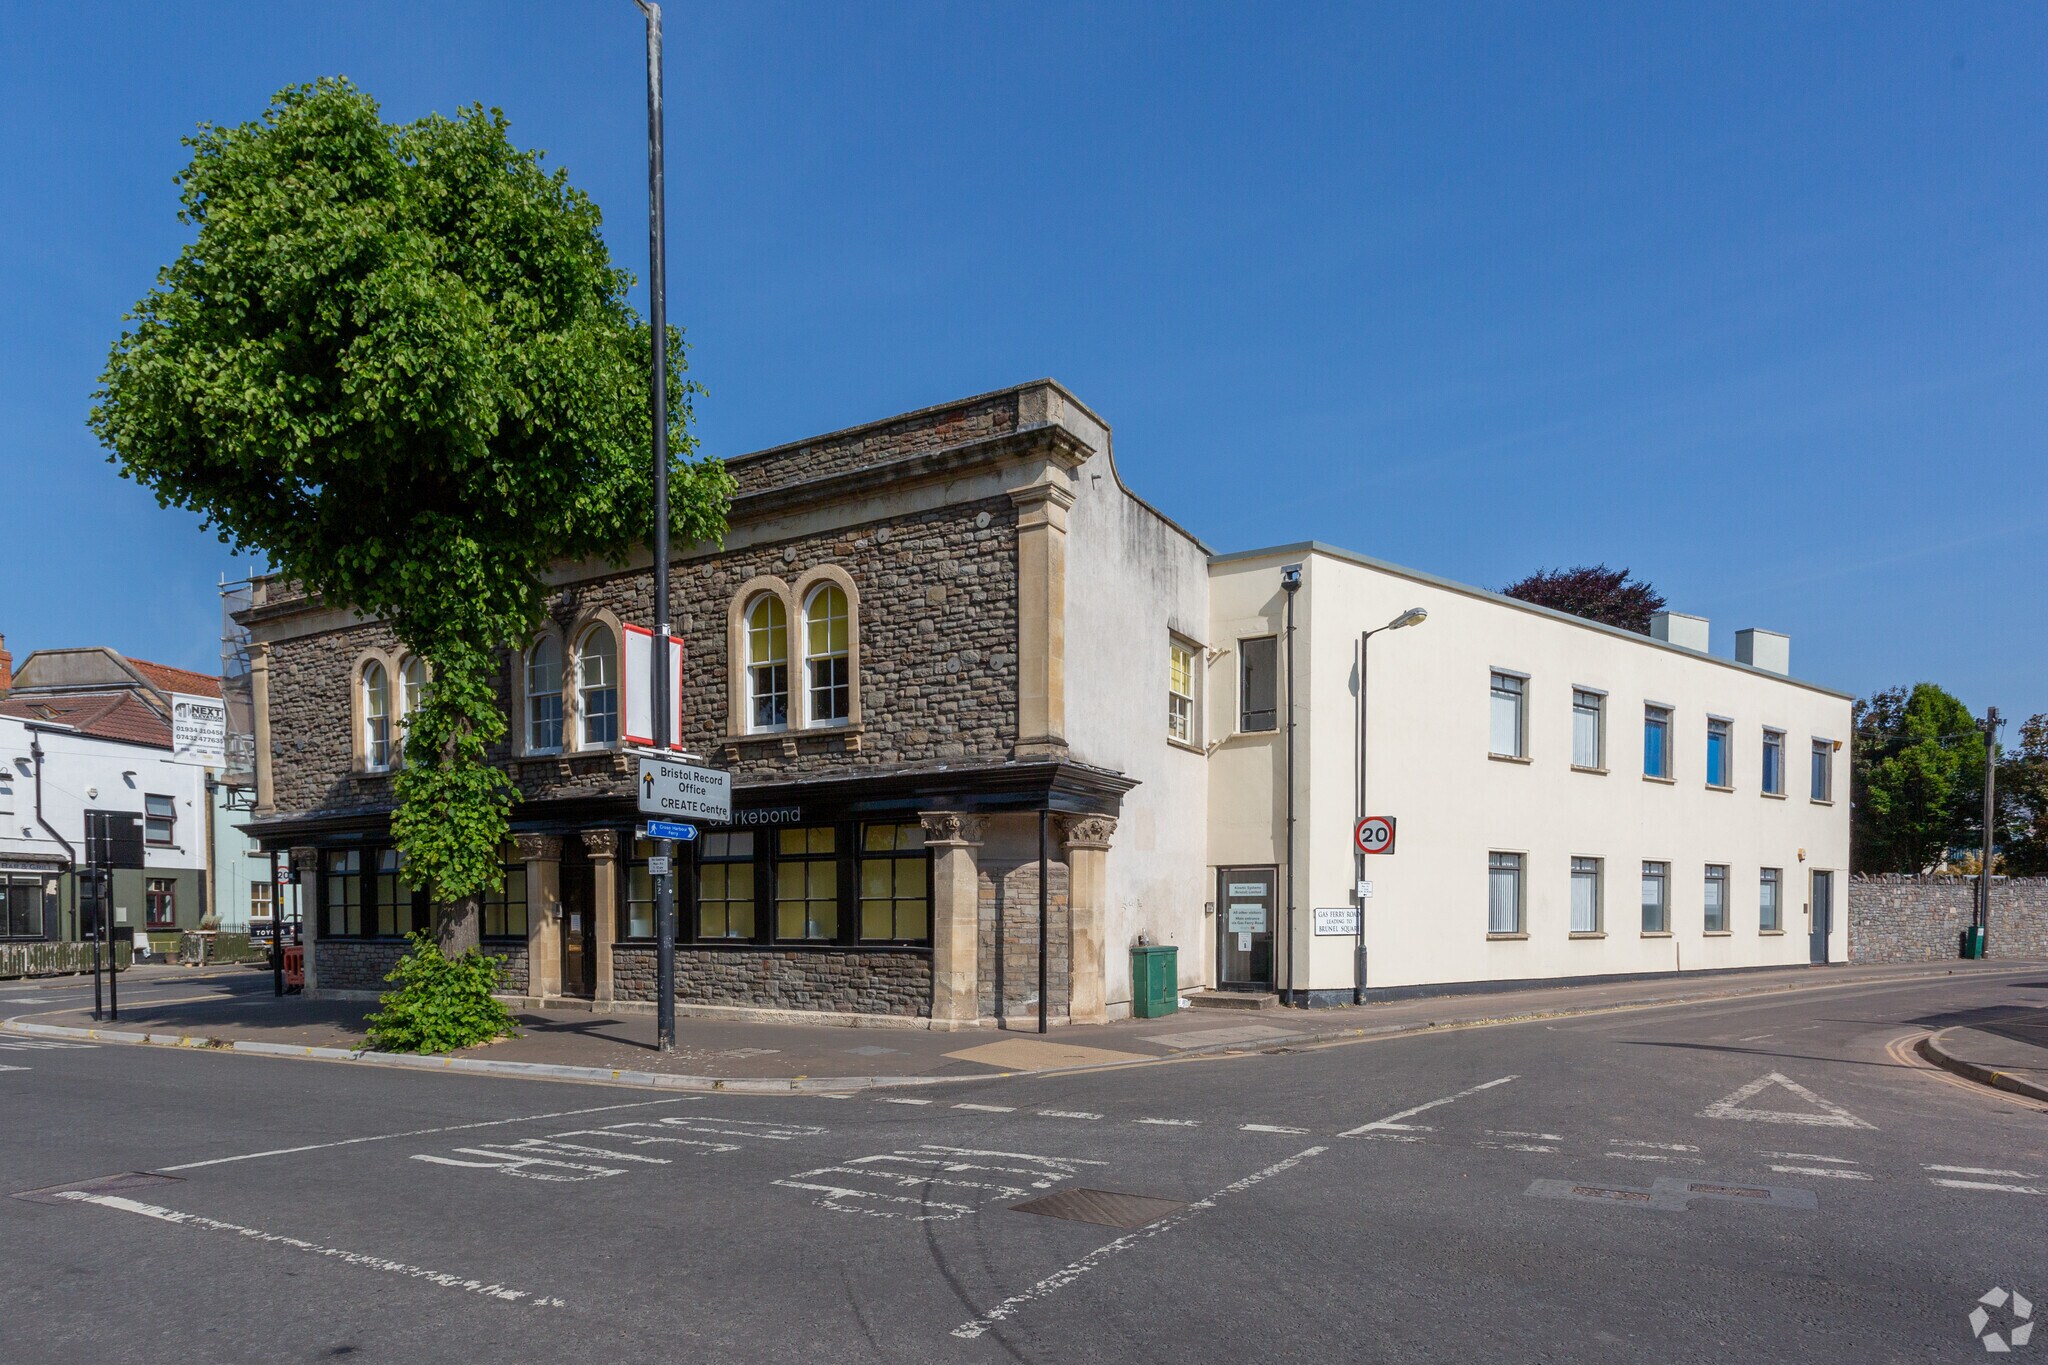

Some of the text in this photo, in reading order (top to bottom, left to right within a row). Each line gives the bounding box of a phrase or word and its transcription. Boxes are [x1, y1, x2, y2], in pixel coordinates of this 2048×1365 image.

[192, 706, 221, 716] NEXT
[661, 767, 723, 785] Bristol Record
[679, 782, 706, 795] Office
[661, 798, 727, 815] CREATE Centre
[1362, 827, 1388, 843] 20
